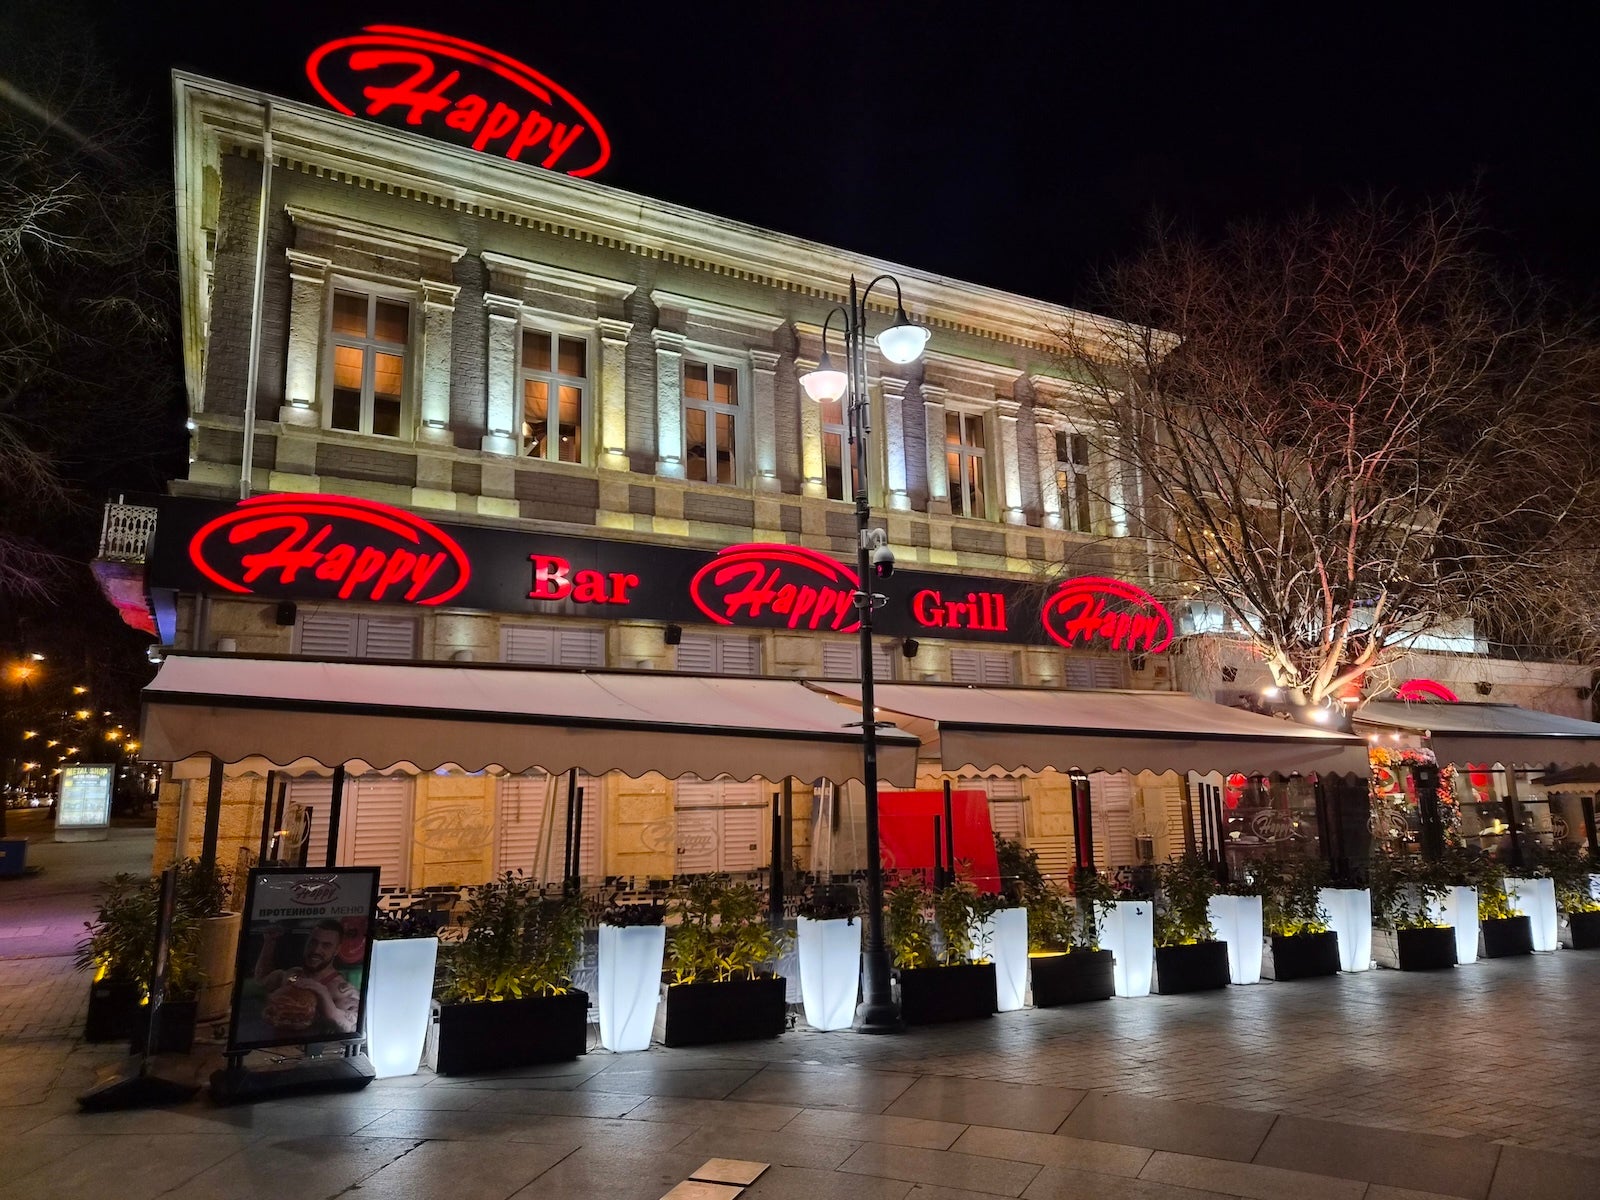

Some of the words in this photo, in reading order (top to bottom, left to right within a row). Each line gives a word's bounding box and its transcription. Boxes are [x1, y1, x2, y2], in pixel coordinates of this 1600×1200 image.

[349, 51, 584, 168] Happy
[229, 516, 447, 600] Happy
[529, 554, 639, 605] Bar
[715, 561, 857, 630] Happy
[913, 590, 1007, 632] Grill
[1058, 593, 1161, 651] Happy
[331, 905, 364, 915] МЕНЮ
